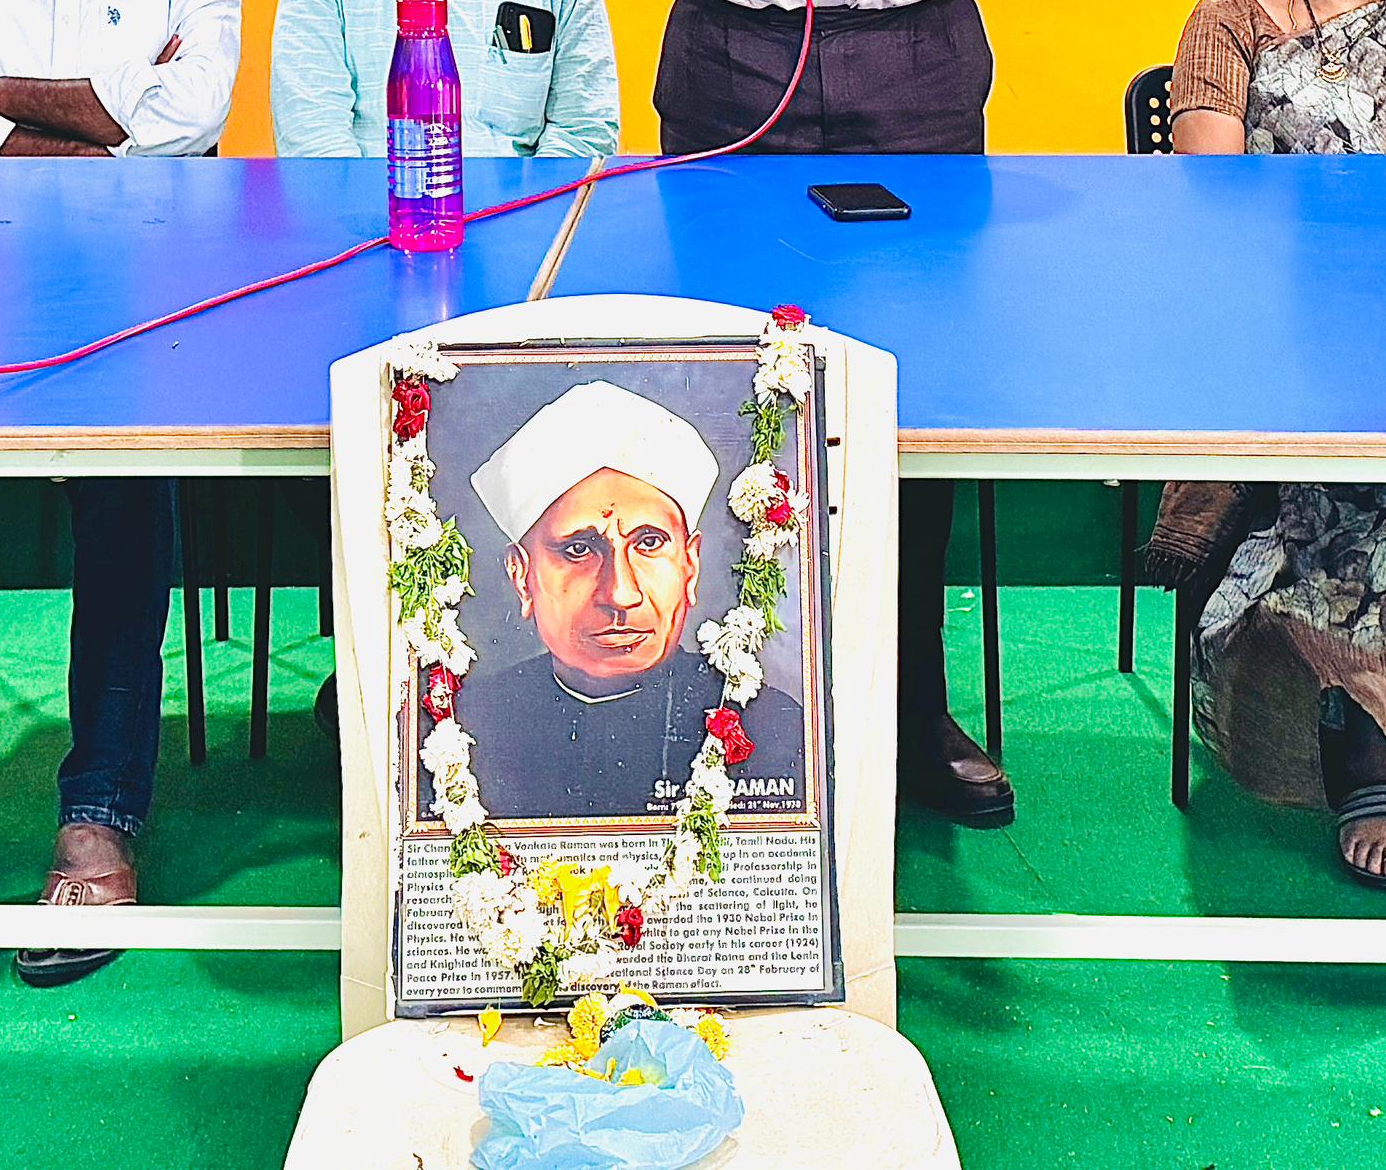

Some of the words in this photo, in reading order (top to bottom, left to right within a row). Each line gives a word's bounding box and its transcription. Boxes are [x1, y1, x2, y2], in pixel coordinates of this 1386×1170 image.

[655, 780, 681, 798] Sir
[729, 801, 745, 810] ied:
[407, 844, 421, 853] Sir
[560, 841, 596, 850] Raman
[599, 841, 619, 849] was
[622, 839, 646, 848] born
[649, 838, 659, 847] in
[736, 836, 763, 846] Tamil
[766, 836, 797, 846] Nadu.
[800, 835, 816, 845] His
[407, 857, 438, 866] father
[599, 852, 619, 862] and
[723, 852, 736, 861] up
[739, 850, 749, 859] in
[768, 848, 816, 858] academic
[407, 869, 455, 880] atmosph
[733, 861, 802, 872] Professorship
[807, 860, 817, 869] in
[407, 882, 444, 893] Physics
[731, 874, 782, 884] continued
[788, 873, 817, 884] doing
[407, 895, 452, 904] research
[693, 889, 703, 898] of
[708, 887, 749, 898] Science,
[753, 887, 797, 897] Calcutta.
[802, 886, 817, 896] On
[407, 908, 454, 918] February
[676, 901, 692, 911] the
[699, 900, 750, 911] scattering
[756, 899, 766, 909] of
[773, 899, 799, 910] light,
[805, 899, 818, 909] he
[407, 919, 463, 930] discovered
[647, 915, 693, 924] awarded
[697, 915, 713, 924] the
[717, 914, 742, 923] 1930
[745, 913, 776, 922] Nobel
[779, 912, 805, 922] Prize
[808, 912, 818, 921] in
[407, 934, 446, 945] Physics.
[450, 933, 464, 942] He
[670, 928, 679, 937] to
[683, 928, 700, 938] get
[703, 929, 722, 938] any
[725, 926, 757, 936] Nobel
[760, 925, 785, 935] Prize
[788, 925, 799, 934] in
[802, 924, 818, 934] the
[407, 947, 451, 956] sciences.
[456, 946, 470, 955] He
[619, 941, 646, 952] Royal
[649, 940, 685, 951] Society
[688, 939, 715, 951] early
[718, 939, 728, 949] in
[731, 939, 746, 949] his
[749, 940, 783, 948] career
[785, 937, 819, 949] (1924)
[406, 960, 426, 969] and
[430, 959, 477, 970] Knighted
[481, 959, 492, 968] in
[616, 954, 653, 964] warded
[657, 953, 674, 963] the
[677, 952, 712, 962] Bharat
[715, 952, 745, 962] Ratna
[748, 951, 768, 961] and
[771, 951, 788, 960] the
[791, 950, 819, 960] Lenin
[408, 974, 436, 983] Peace
[441, 972, 467, 982] Prize
[471, 972, 481, 981] in
[485, 971, 514, 980] 1957.
[610, 967, 652, 977] ational
[655, 967, 694, 977] Science
[697, 966, 717, 977] Day
[721, 967, 734, 975] on
[759, 964, 805, 975] February
[810, 963, 820, 973] of
[406, 988, 435, 997] every
[437, 987, 460, 996] year
[463, 985, 472, 994] to
[475, 986, 523, 994] commem
[570, 982, 620, 992] discovery
[652, 979, 689, 989] Raman
[690, 978, 722, 989] effect.
